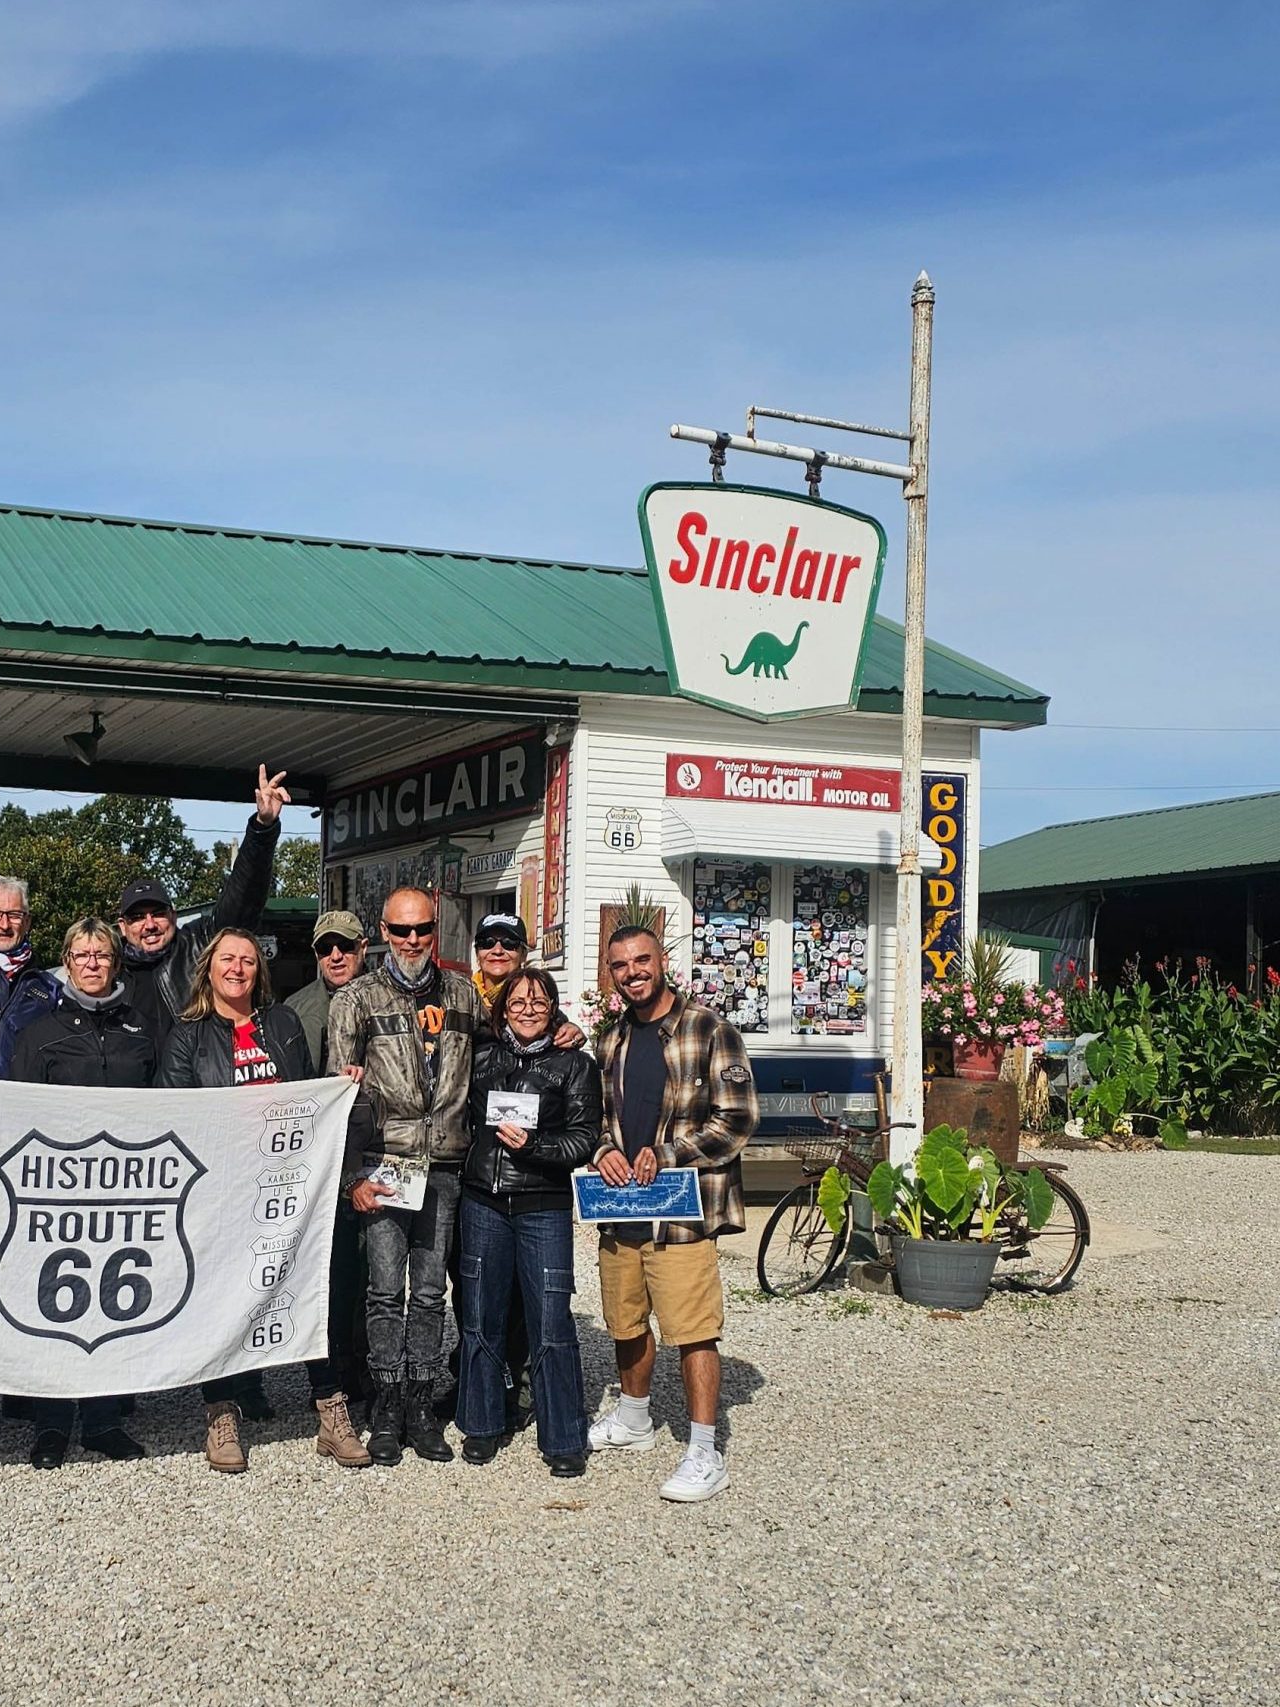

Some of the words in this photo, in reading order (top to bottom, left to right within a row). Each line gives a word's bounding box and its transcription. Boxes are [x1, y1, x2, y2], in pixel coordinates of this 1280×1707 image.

[669, 511, 861, 603] Sinclair
[715, 760, 748, 772] Protect
[751, 763, 769, 775] Your
[772, 765, 819, 778] Investment
[821, 769, 842, 780] with
[333, 745, 526, 843] SINCLAIR
[823, 788, 868, 805] MOTOR
[872, 792, 891, 807] OIL
[611, 832, 634, 847] 66
[269, 1106, 311, 1118] OKLAHOMA
[271, 1130, 304, 1153] 66
[21, 1156, 180, 1190] HISTORIC
[268, 1172, 300, 1184] KANSAS
[265, 1196, 297, 1219] 66
[28, 1210, 166, 1243] ROUTE
[38, 1247, 154, 1322] 66
[262, 1261, 288, 1287] 66
[252, 1323, 282, 1347] 66
